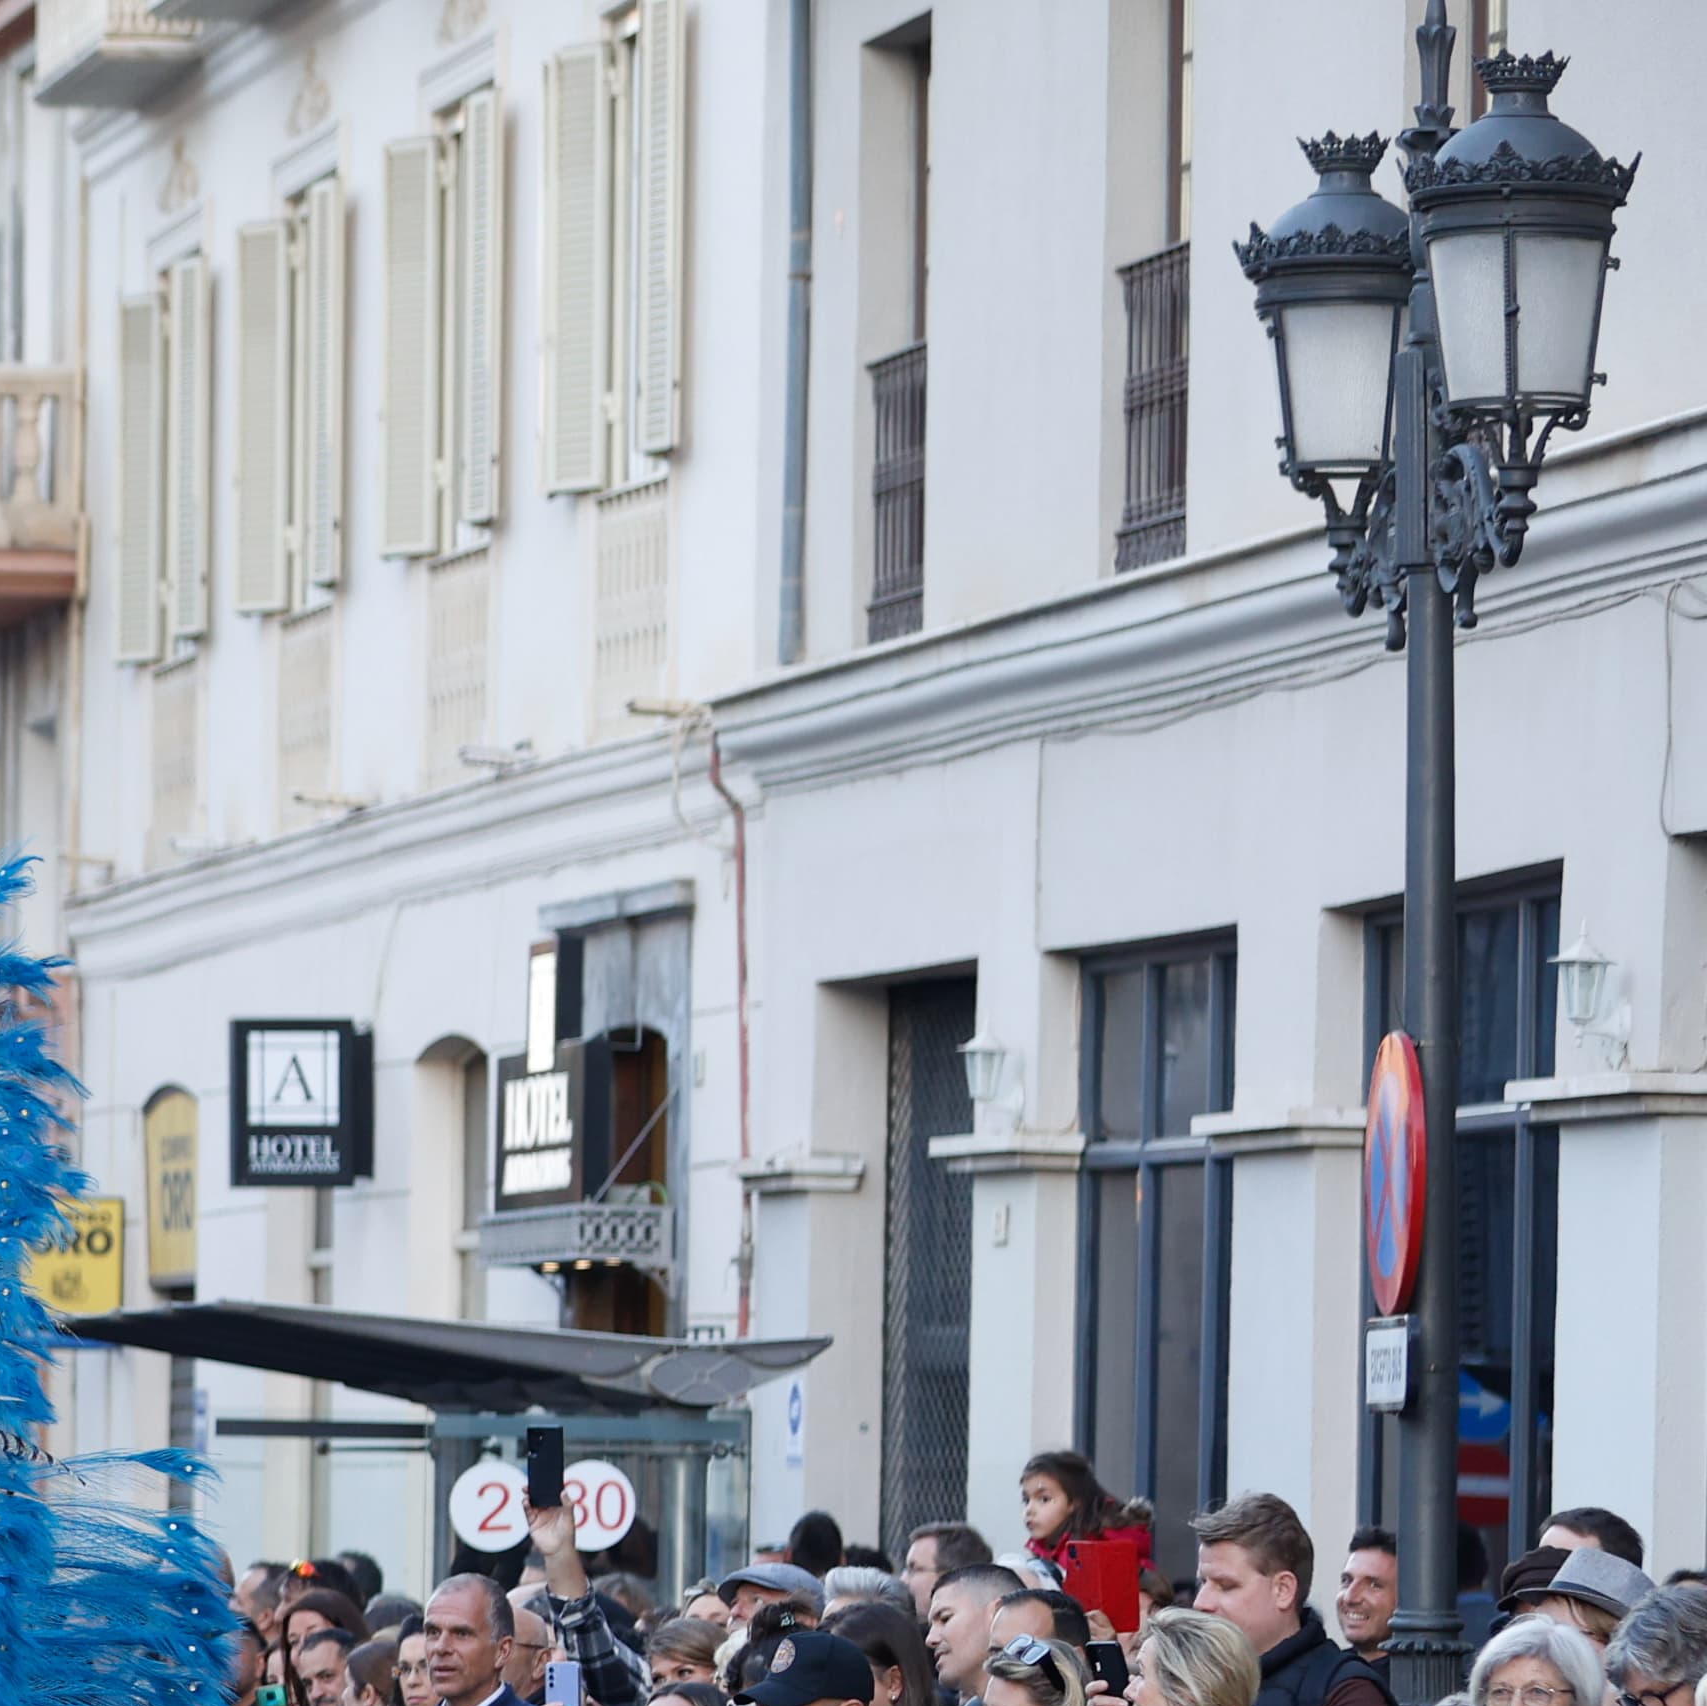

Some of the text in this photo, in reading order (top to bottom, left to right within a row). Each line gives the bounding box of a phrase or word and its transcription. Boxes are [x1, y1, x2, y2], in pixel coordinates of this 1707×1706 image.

[273, 1054, 314, 1102] A
[502, 1072, 573, 1150] HOTEL
[248, 1134, 339, 1159] HOTEL
[477, 1482, 512, 1532] 2
